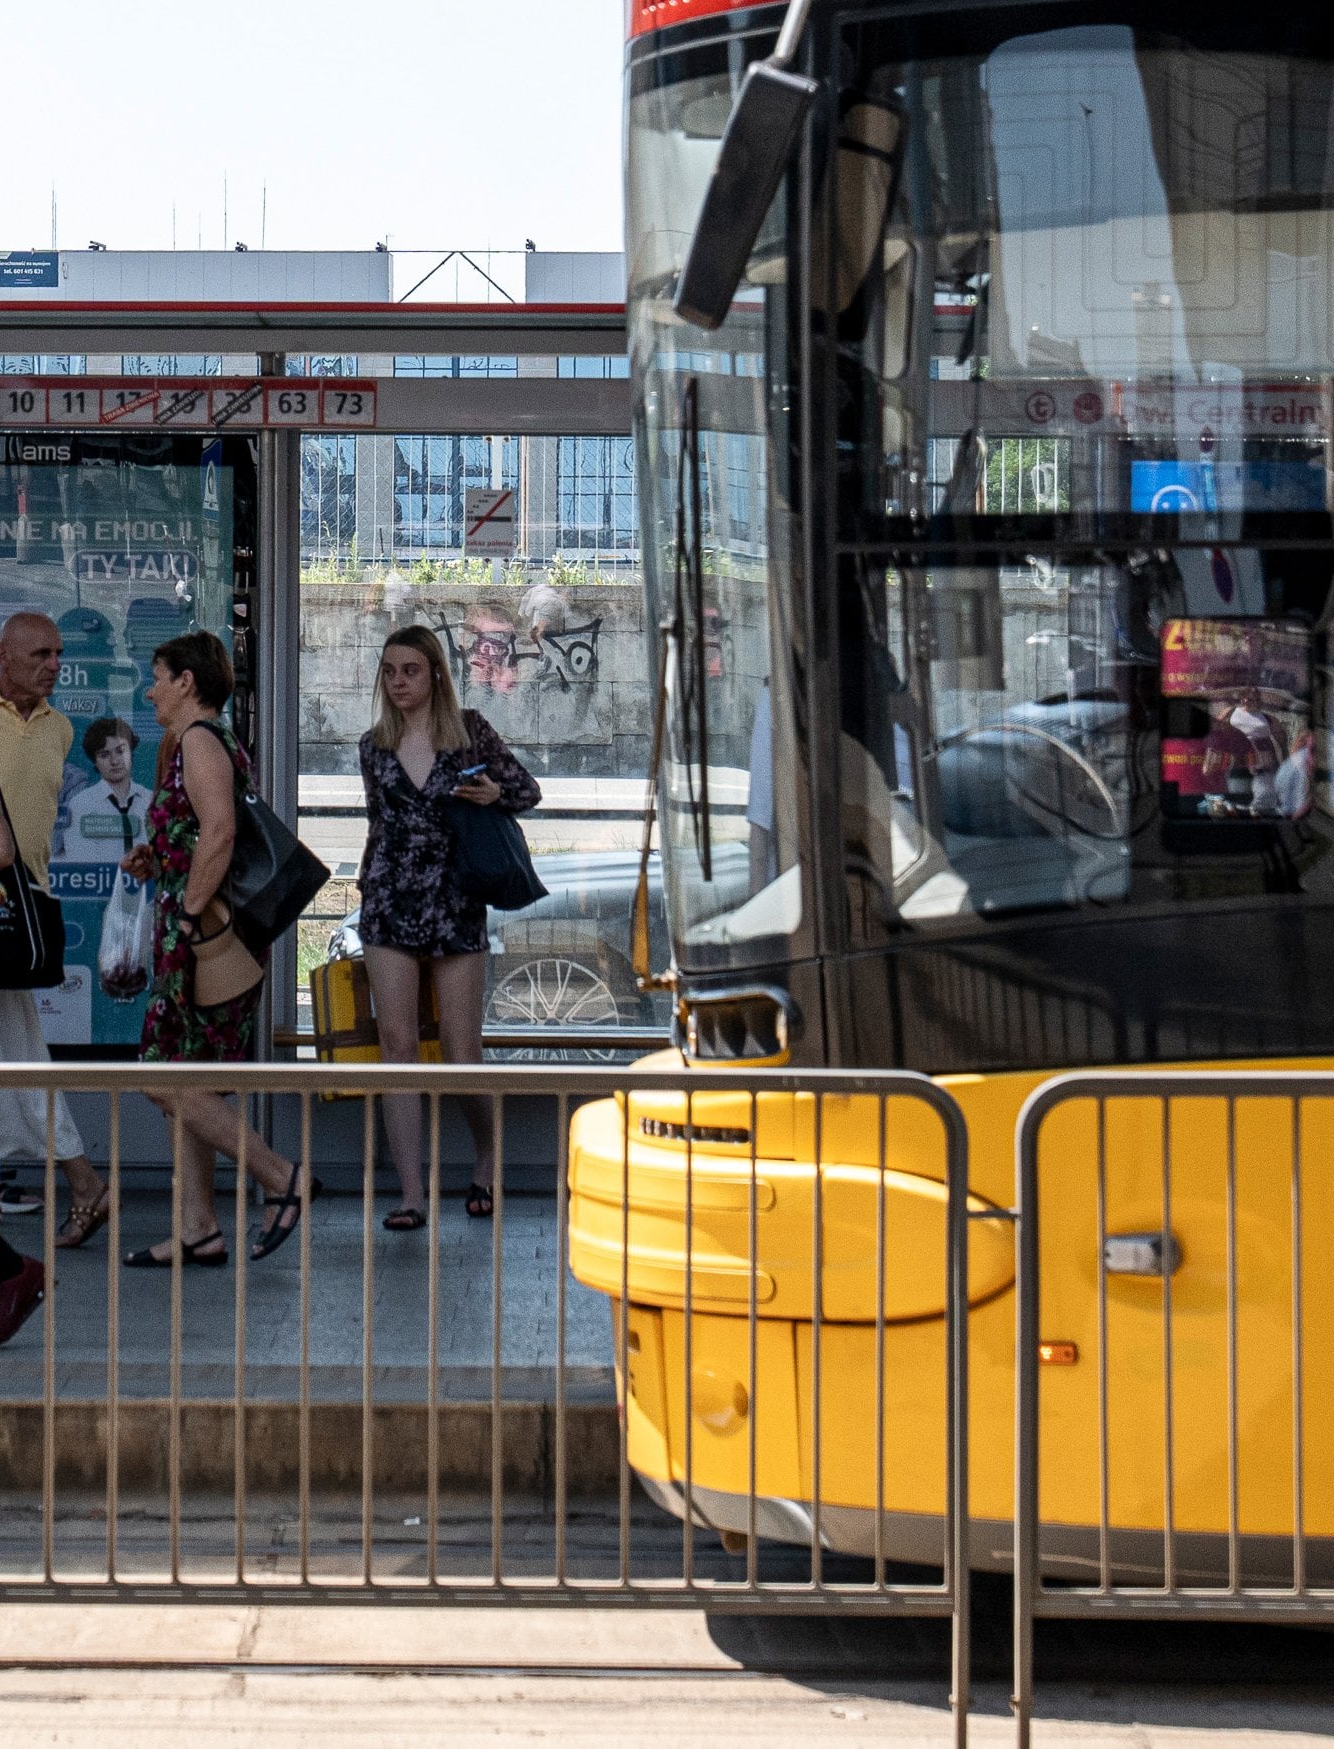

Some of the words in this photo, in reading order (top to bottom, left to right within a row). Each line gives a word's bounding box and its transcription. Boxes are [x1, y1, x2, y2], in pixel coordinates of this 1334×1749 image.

[9, 391, 34, 413] 10
[62, 392, 85, 413] 11
[278, 392, 306, 414] 63
[334, 392, 362, 415] 73
[23, 445, 71, 461] ams
[0, 521, 44, 541] NIE
[51, 521, 88, 541] MA
[80, 554, 118, 580] TY
[125, 554, 188, 580] TAK!
